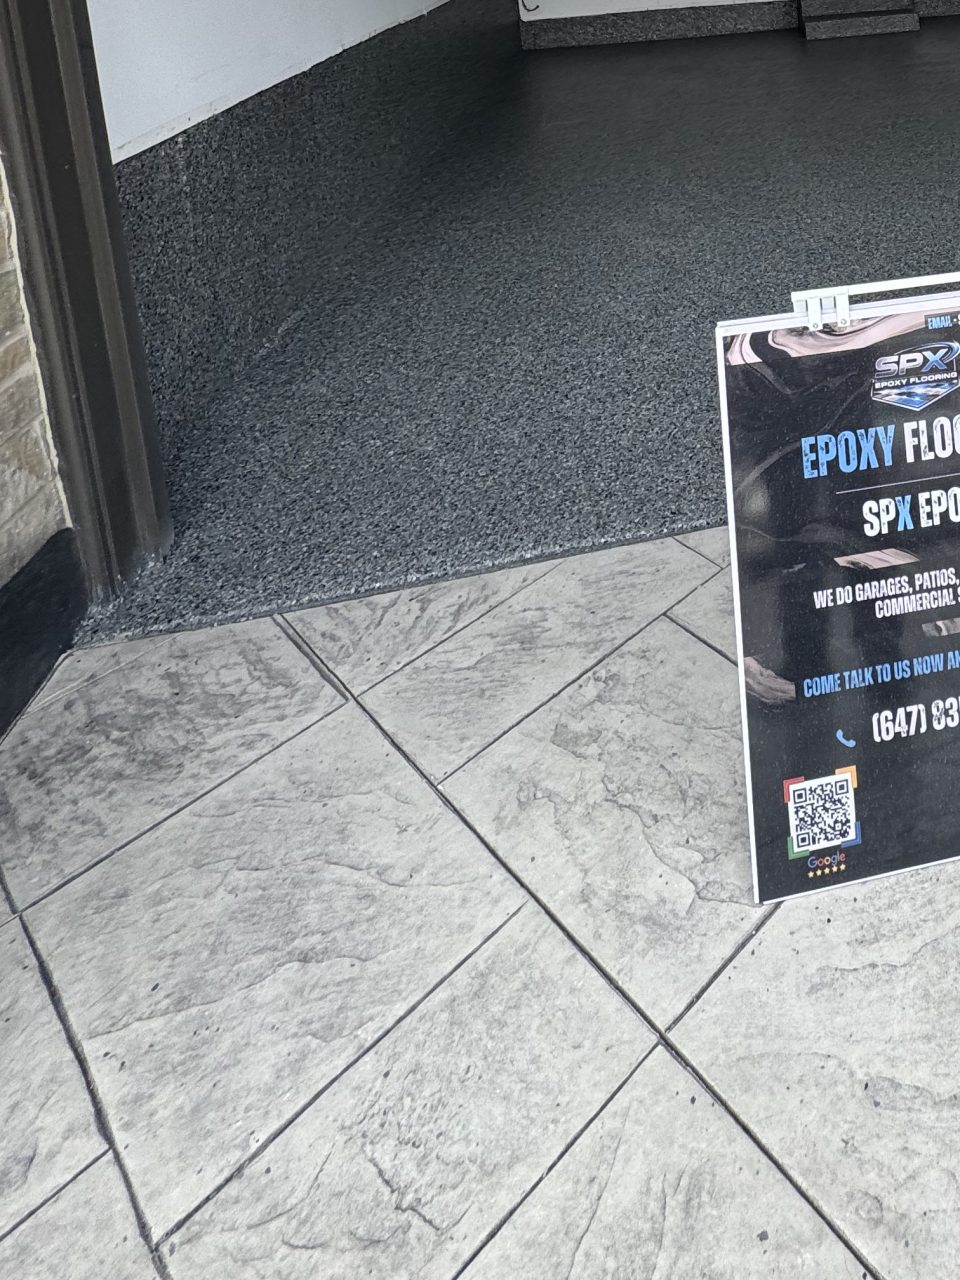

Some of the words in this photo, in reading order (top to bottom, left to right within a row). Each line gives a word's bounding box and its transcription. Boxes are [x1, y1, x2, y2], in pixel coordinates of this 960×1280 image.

[927, 316, 953, 330] EMAIL
[875, 348, 949, 379] SPX
[875, 378, 908, 389] EPOXY
[909, 371, 958, 384] FLOORING
[801, 424, 895, 479] EPOXY
[862, 494, 914, 537] SPX
[813, 588, 834, 609] WE
[835, 585, 853, 605] DO
[854, 575, 913, 602] GARAGES,
[914, 567, 960, 591] PATIOS,
[874, 587, 956, 619] COMMERCIAL
[803, 672, 842, 698] COME
[843, 666, 874, 690] TALK
[875, 663, 892, 684] TO
[893, 659, 911, 680] US
[912, 652, 944, 676] NOW
[871, 703, 928, 743] (647)
[807, 850, 846, 868] Google
